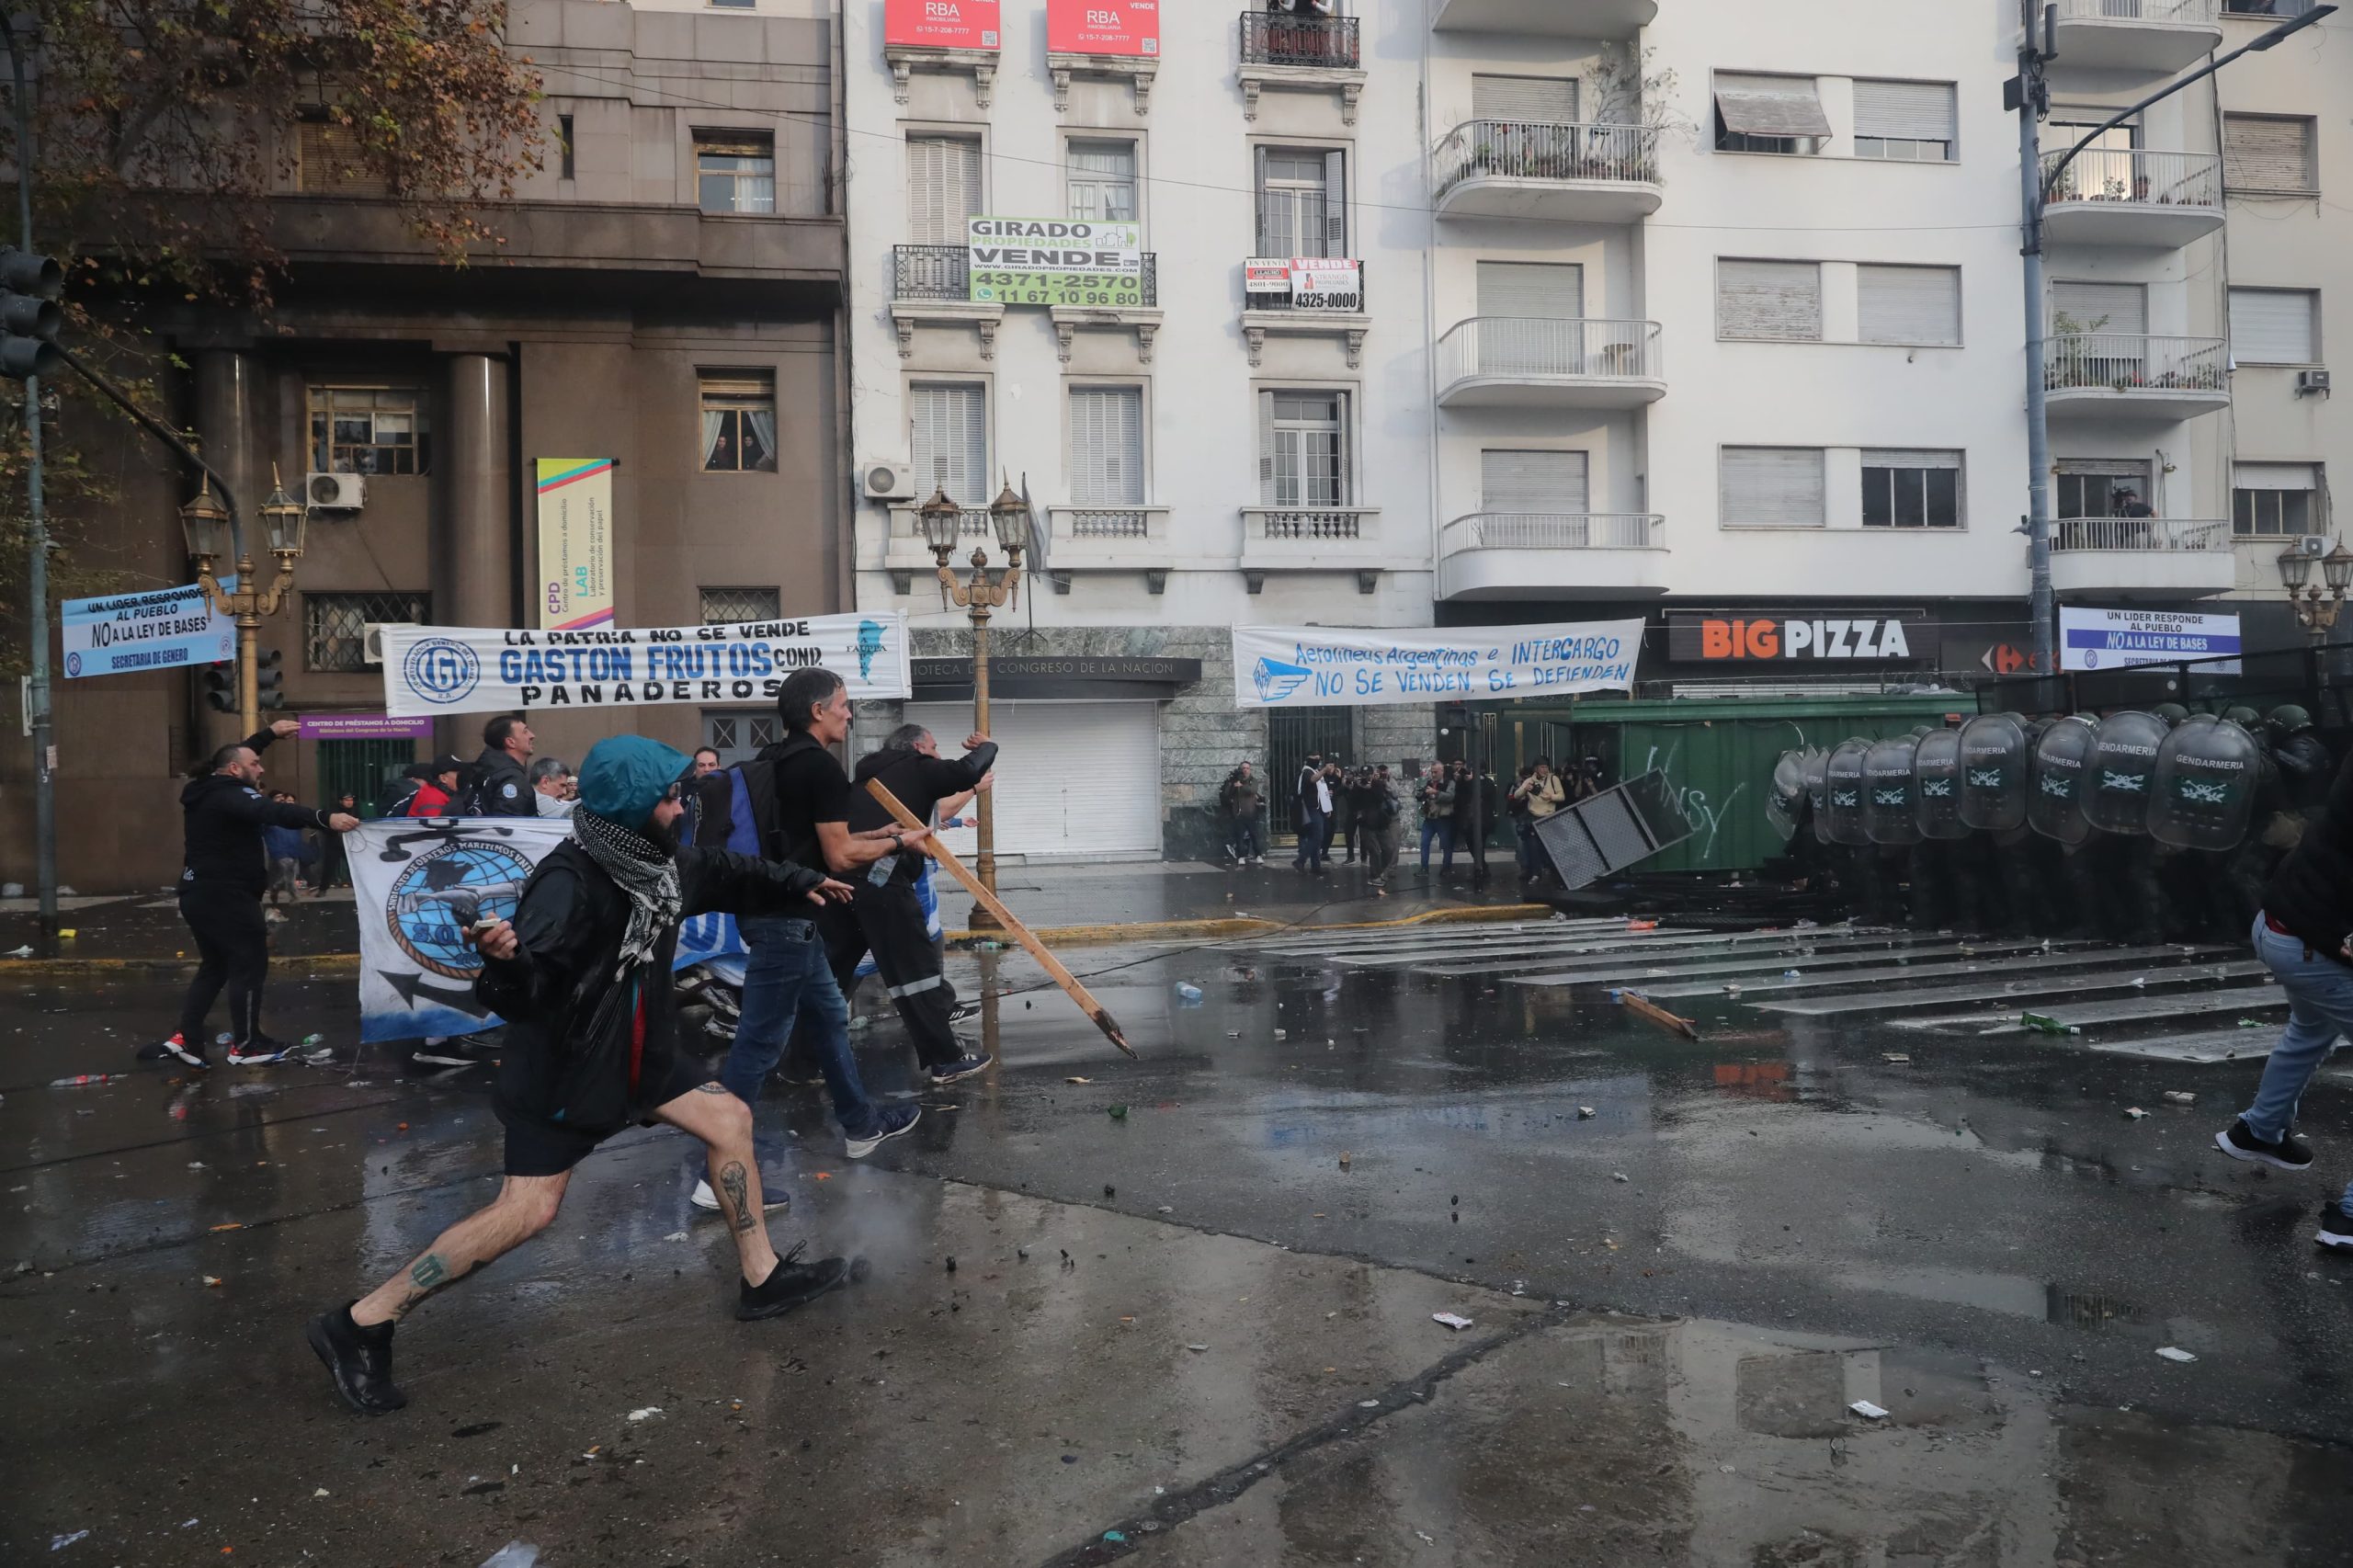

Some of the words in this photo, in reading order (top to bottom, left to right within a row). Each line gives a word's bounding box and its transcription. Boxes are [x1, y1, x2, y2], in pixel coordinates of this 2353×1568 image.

[926, 2, 960, 17] RBA
[1131, 2, 1154, 10] VENDE
[1086, 10, 1120, 24] RBA
[972, 221, 1092, 238] GIRADO
[971, 236, 1092, 248] PROPIEDADES
[972, 248, 1120, 267] VENDE
[1296, 259, 1352, 269] VENDE
[976, 273, 1137, 289] 4371-2570
[999, 290, 1018, 301] 11
[1027, 291, 1050, 302] 67
[1058, 291, 1080, 303] 10
[1086, 292, 1108, 304] 96
[1115, 293, 1138, 305] 80
[1295, 292, 1357, 308] 4325-0000
[588, 545, 596, 554] de
[562, 578, 568, 587] de
[575, 566, 588, 597] LAB
[88, 602, 104, 614] UN
[107, 598, 139, 610] LIDER
[549, 582, 561, 614] CPD
[116, 608, 131, 622] AL
[134, 604, 178, 619] PUEBLO
[2107, 611, 2121, 620] UN
[2124, 612, 2152, 622] LIDER
[2154, 613, 2204, 624] RESPONDE
[92, 622, 111, 648] NO
[113, 631, 120, 642] A
[122, 626, 135, 642] LA
[137, 623, 155, 640] LEY
[158, 621, 172, 636] DE
[175, 616, 207, 634] BASES
[505, 631, 535, 645] LA
[650, 629, 682, 642] NO
[697, 626, 726, 641] SE
[739, 620, 811, 639] VENDE
[2131, 622, 2143, 631] AL
[2145, 623, 2182, 633] PUEBLO
[1702, 619, 1779, 658] BIG
[1784, 619, 1910, 658] PIZZA
[2106, 631, 2125, 650] NO
[2126, 637, 2133, 648] A
[2134, 636, 2146, 649] LA
[2148, 636, 2164, 649] LEY
[2166, 637, 2178, 650] DE
[2180, 637, 2208, 651] BASES
[111, 651, 152, 669] SECRETARIA
[153, 651, 162, 665] DE
[162, 648, 188, 664] GENERO
[1386, 643, 1479, 670] Argentinas
[1487, 648, 1499, 662] e
[1511, 636, 1620, 665] INTERCARGO
[500, 646, 632, 684] GASTON
[646, 642, 773, 680] FRUTOS
[914, 664, 961, 676] IOTECA
[996, 662, 1074, 674] CONGRESO
[1080, 662, 1096, 674] DE
[1102, 662, 1117, 674] LA
[1122, 663, 1174, 674] NACION
[1315, 671, 1344, 697] NO
[1356, 669, 1382, 693] SE
[1489, 667, 1517, 691] SE
[1532, 663, 1630, 687] DEFIENDEN
[521, 678, 781, 706] PANADEROS
[2177, 754, 2245, 770] GENDARMERIA
[406, 863, 419, 874] DE
[415, 843, 458, 866] OBREROS
[459, 842, 517, 858] MARITIMOS
